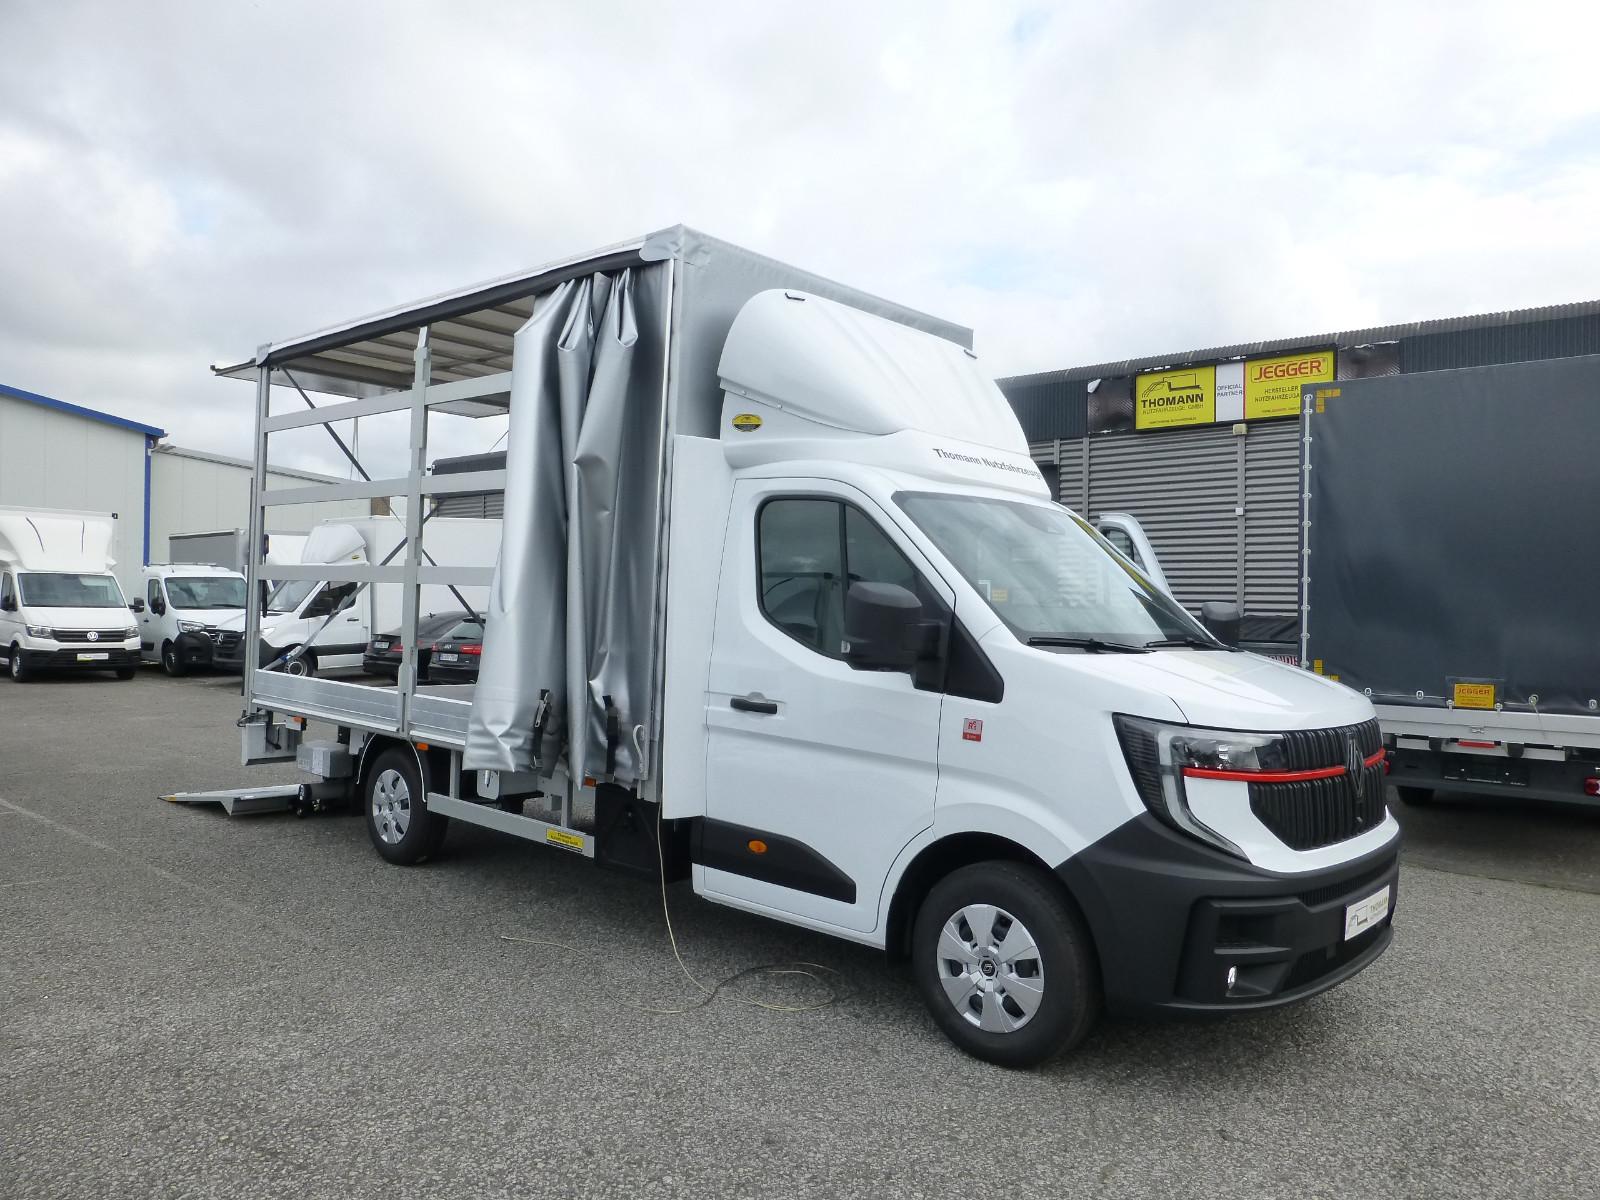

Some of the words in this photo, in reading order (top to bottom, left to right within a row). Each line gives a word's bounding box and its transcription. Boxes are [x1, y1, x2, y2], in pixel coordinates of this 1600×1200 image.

[1254, 359, 1322, 381] JEGGER
[1216, 383, 1242, 391] OFFICIAL
[1264, 385, 1299, 395] HERSTELLER
[1141, 392, 1204, 409] THOMANN
[1216, 390, 1243, 398] PARTNER
[932, 447, 982, 465] Thomann
[981, 457, 1042, 480] Nutzfahrzeug
